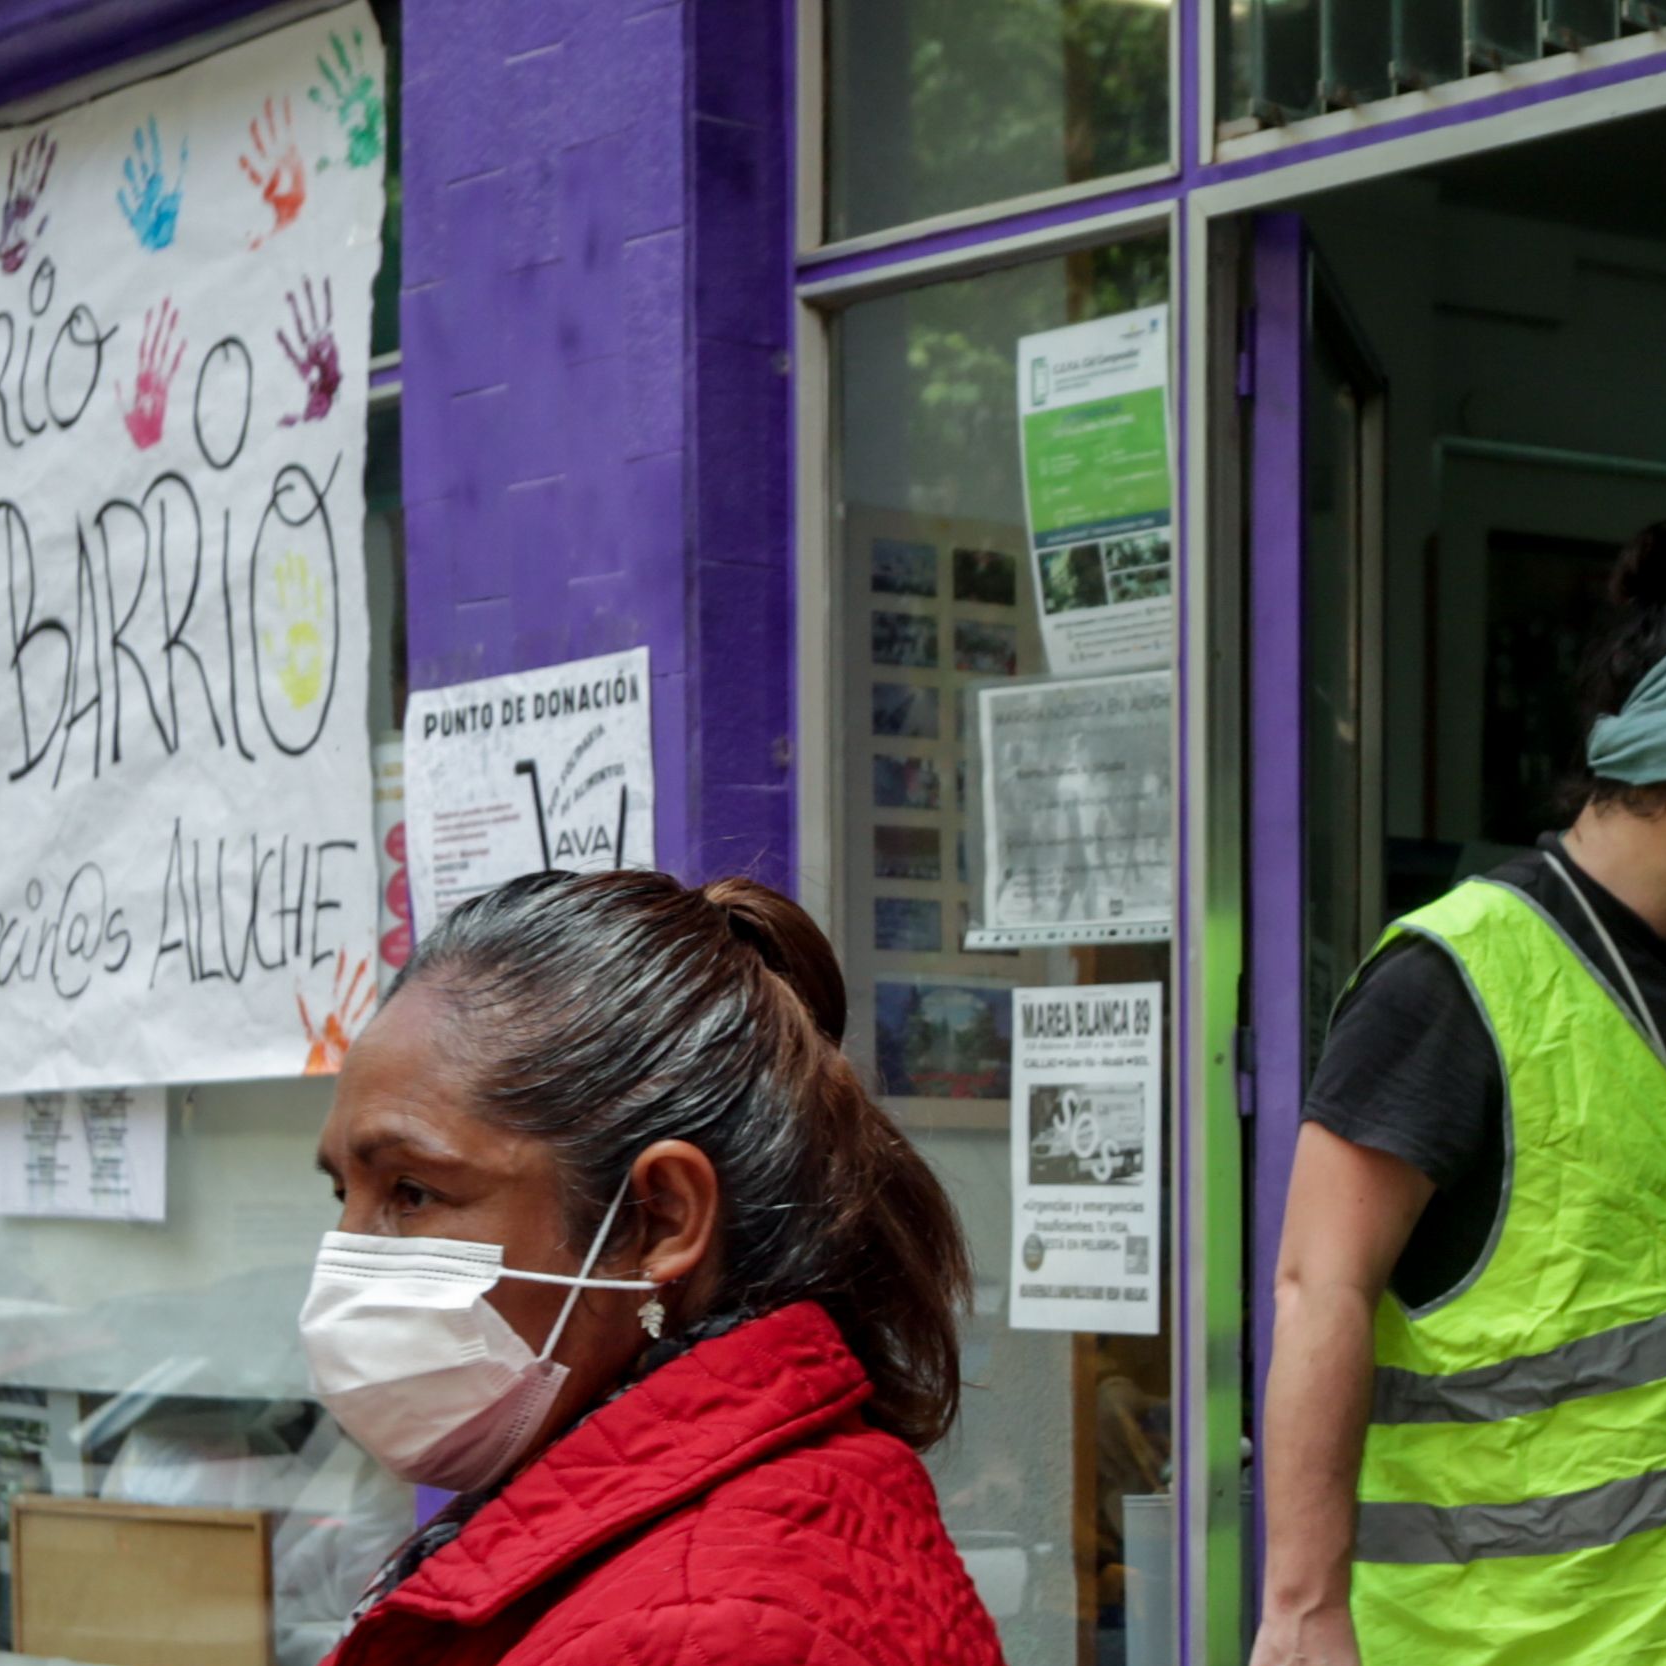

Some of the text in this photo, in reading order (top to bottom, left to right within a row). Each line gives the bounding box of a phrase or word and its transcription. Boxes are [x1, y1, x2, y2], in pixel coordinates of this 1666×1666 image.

[424, 667, 640, 740] PUNTO DE DONACIÓN
[554, 825, 612, 859] AVA
[149, 818, 358, 990] ALUCHE
[1022, 998, 1150, 1038] MAREA BLANCA 89
